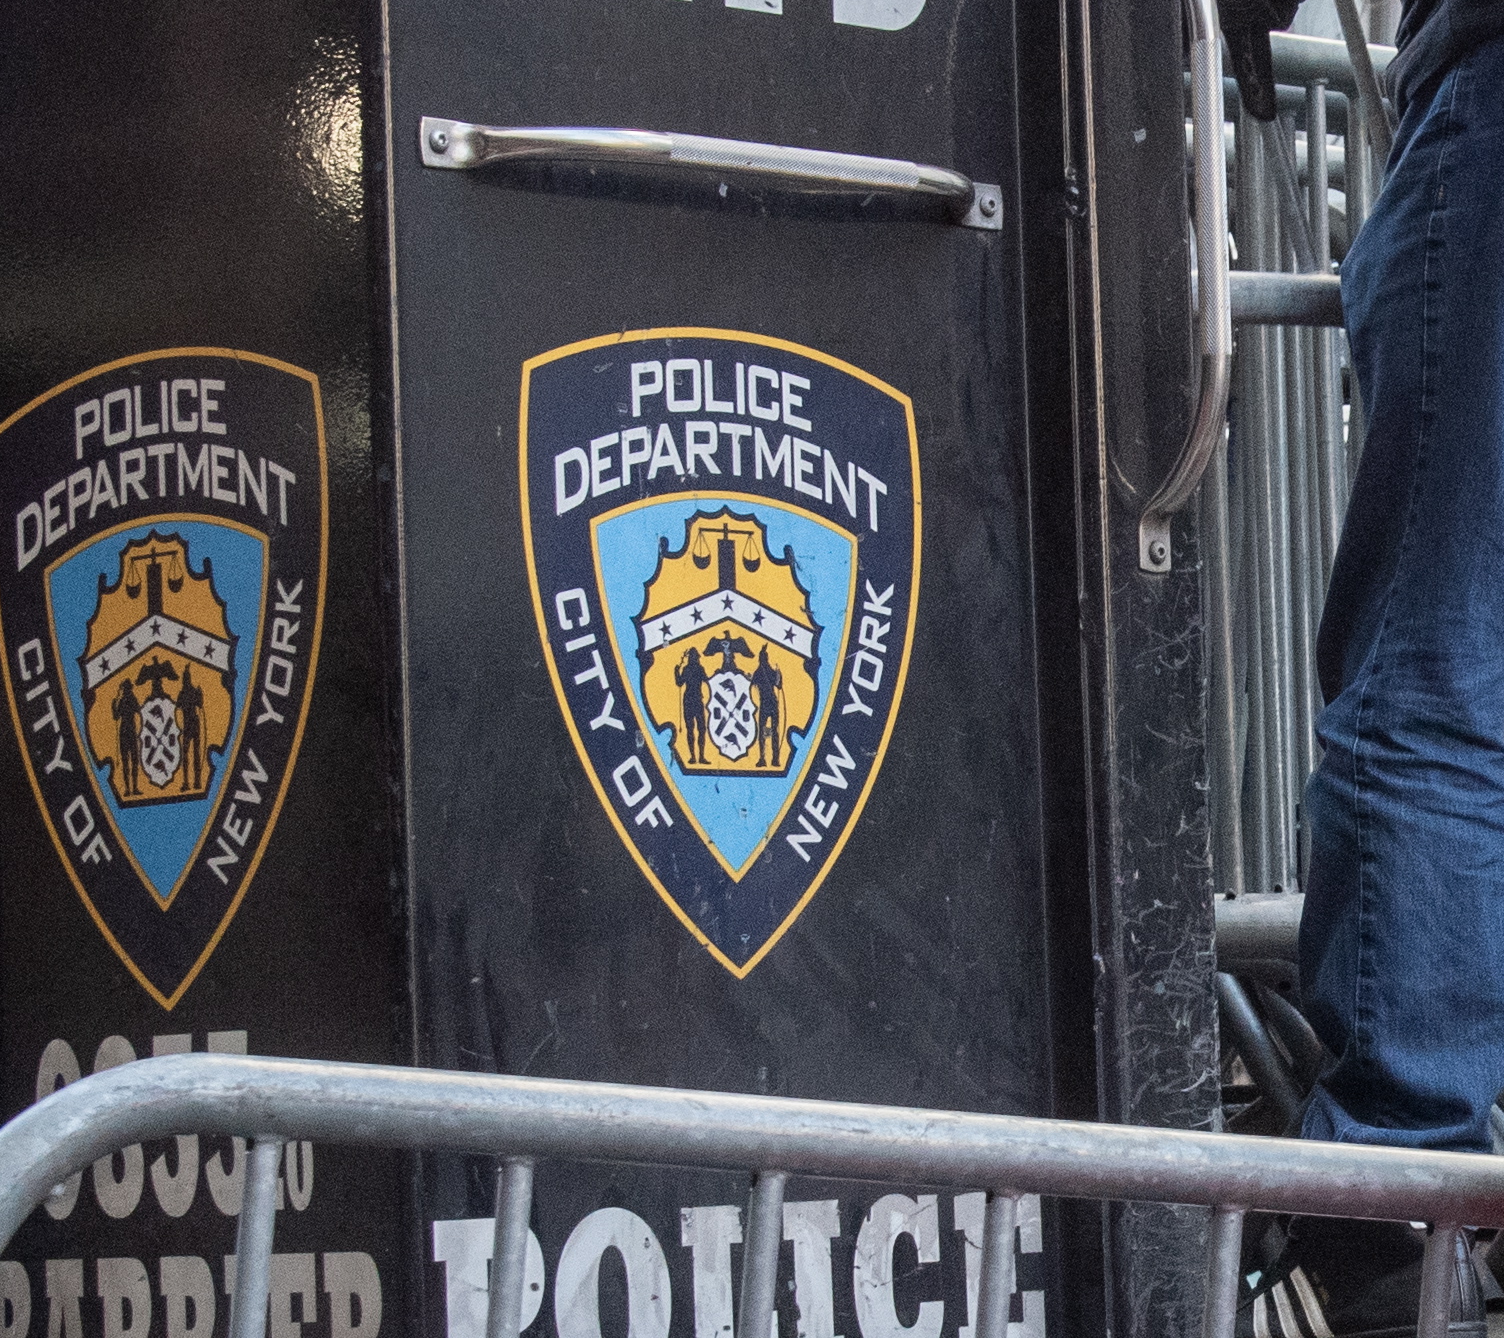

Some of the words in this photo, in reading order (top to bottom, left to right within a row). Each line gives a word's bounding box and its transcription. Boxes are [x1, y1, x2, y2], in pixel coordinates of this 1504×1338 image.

[74, 378, 227, 460] POLICE
[554, 420, 888, 533] DEPARTMENT
[630, 358, 812, 433] POLICE
[16, 442, 297, 573] DEPARTMENT
[17, 637, 74, 775] CITY
[63, 794, 113, 865] OF
[206, 747, 270, 886] NEW
[255, 577, 304, 727] YORK
[554, 587, 626, 732] CITY
[611, 754, 675, 829] OF
[785, 733, 857, 863] NEW
[841, 578, 895, 717] YORK
